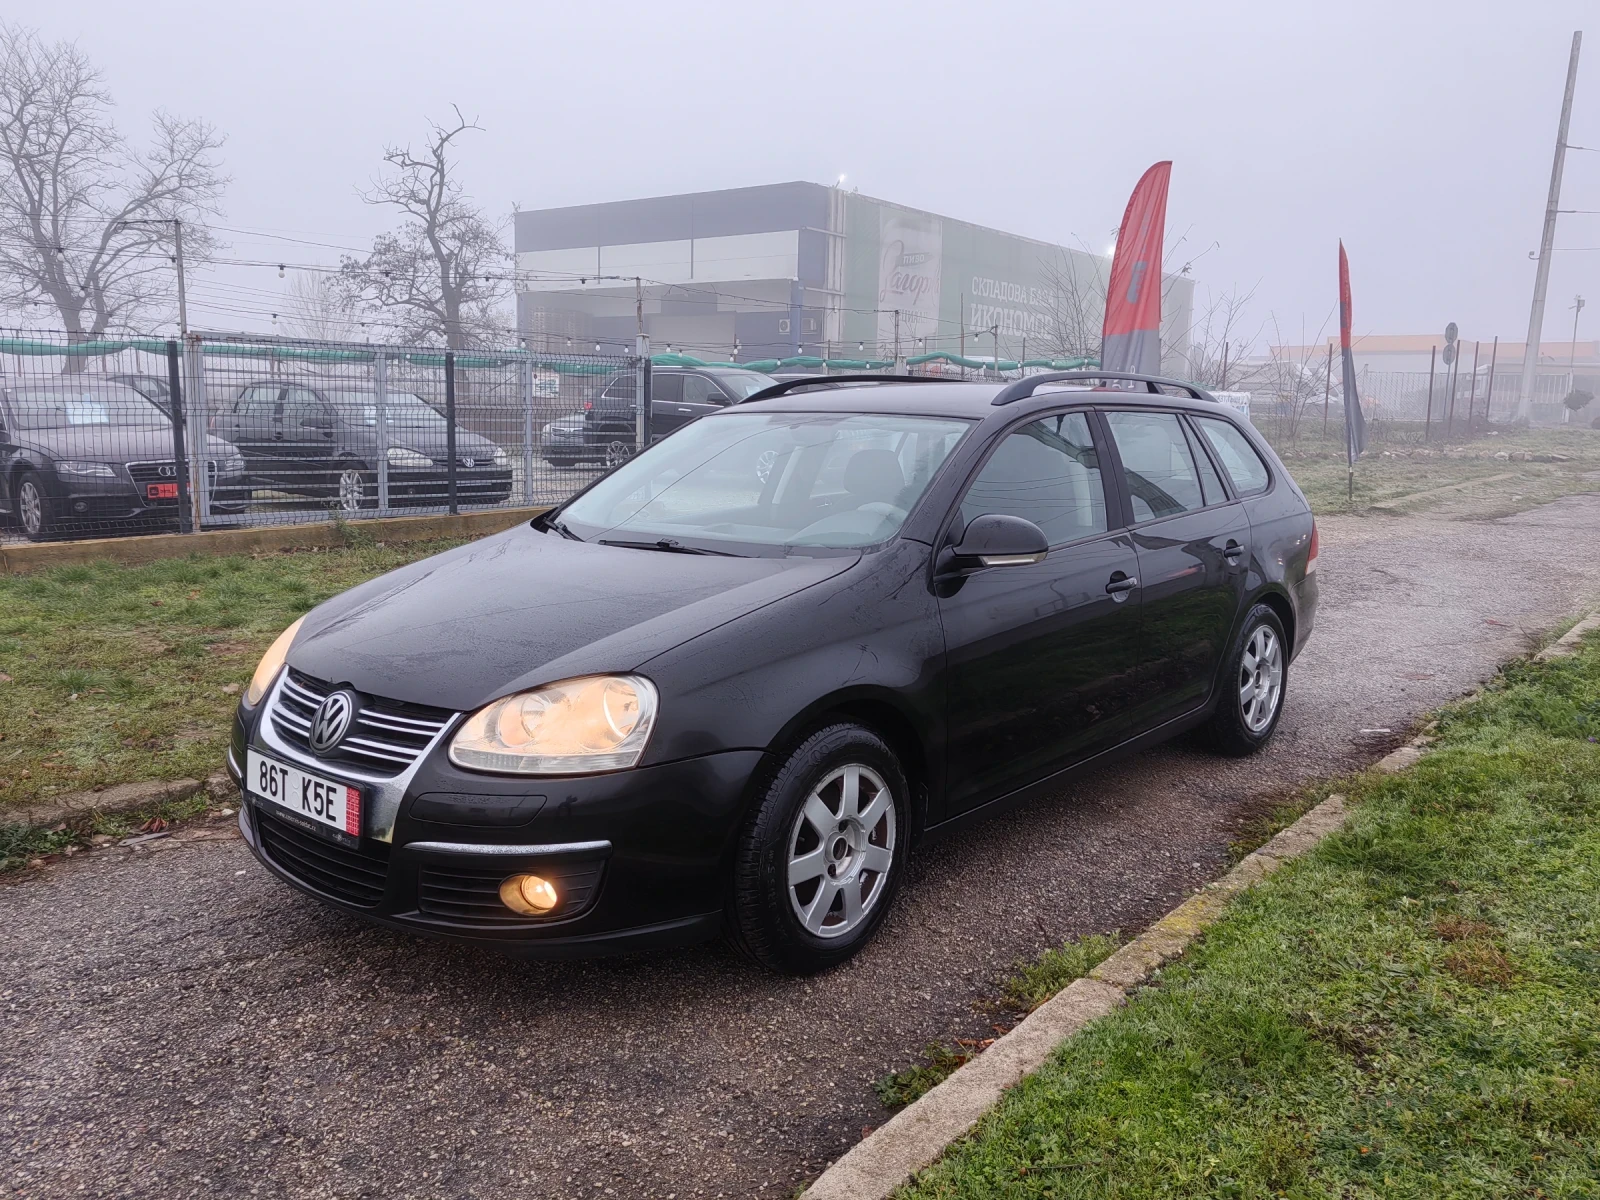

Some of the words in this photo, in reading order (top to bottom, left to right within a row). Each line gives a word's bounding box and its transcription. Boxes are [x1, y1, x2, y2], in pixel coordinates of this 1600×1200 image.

[971, 276, 1028, 304] СКЛАДОВА
[969, 303, 1054, 340] ИКОНОМОВ
[259, 760, 288, 802] 86T
[302, 776, 337, 822] K5E
